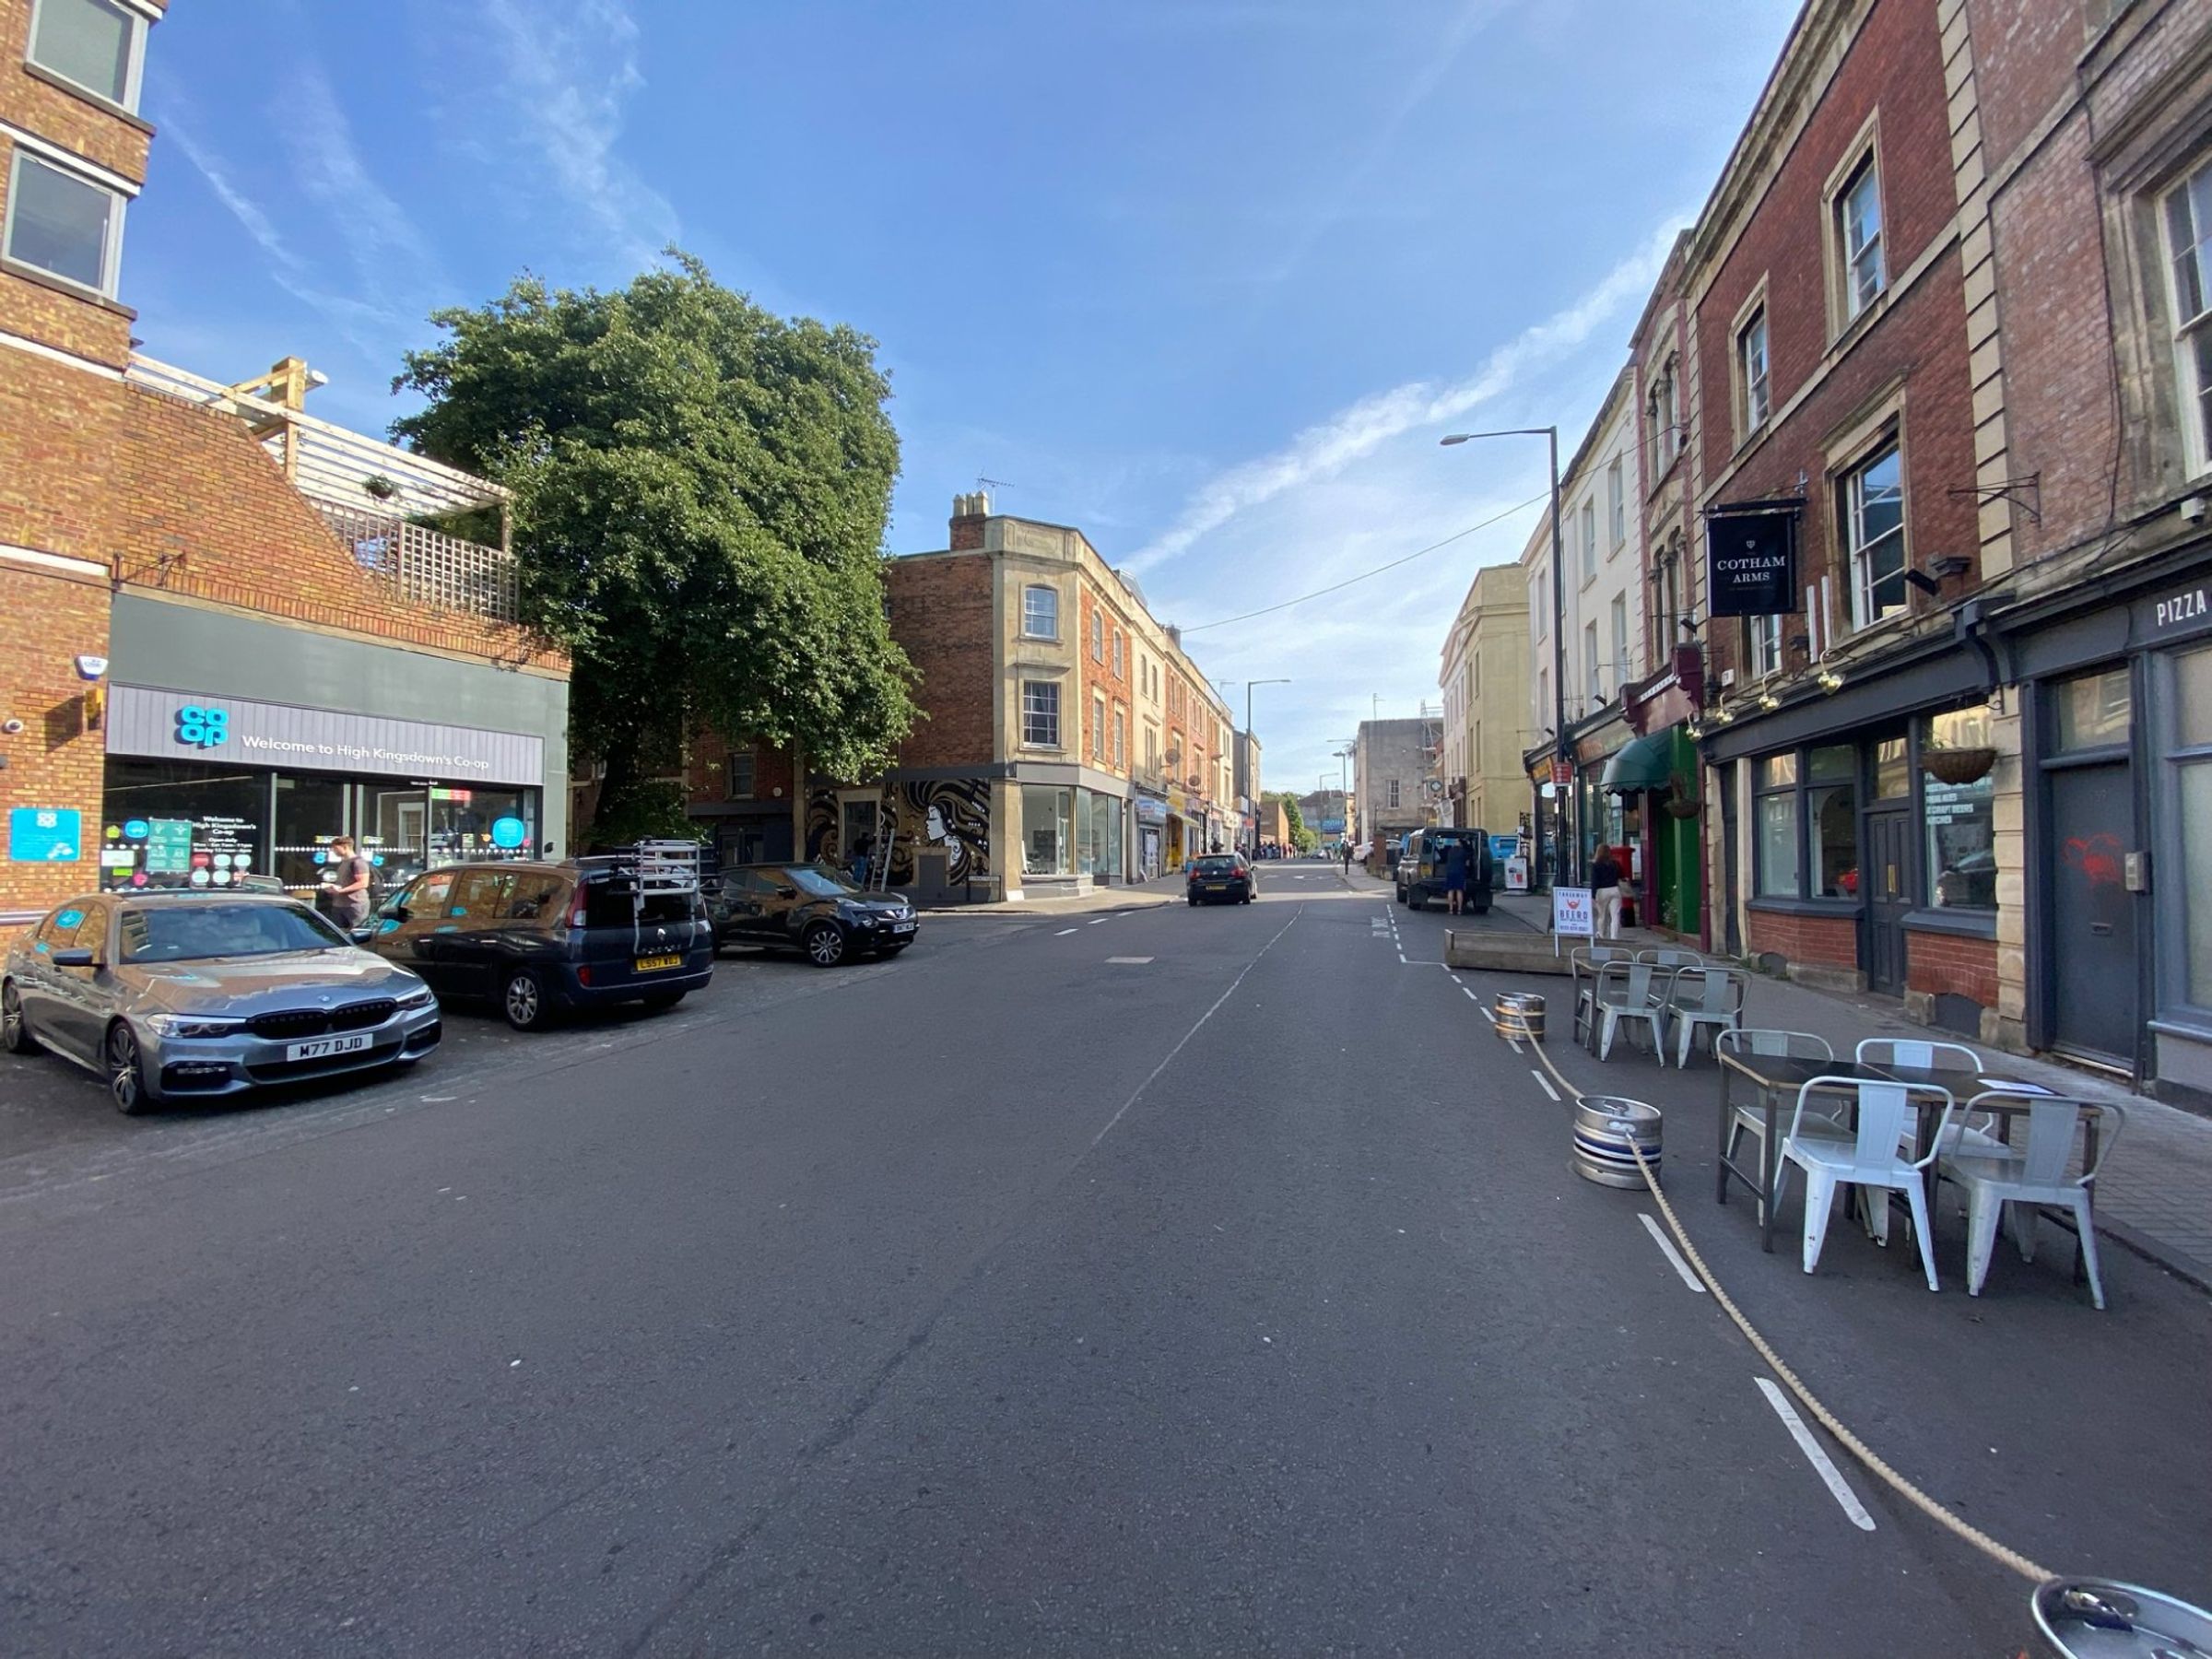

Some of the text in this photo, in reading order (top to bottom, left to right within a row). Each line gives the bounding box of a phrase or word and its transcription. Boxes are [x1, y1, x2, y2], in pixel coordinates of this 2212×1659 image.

[1717, 556, 1786, 571] COTHAM
[1733, 571, 1771, 583] ARMS
[2156, 590, 2206, 627] PIZZA
[241, 735, 489, 771] Welcome to High Kingsdown's Co-op
[335, 1037, 363, 1053] DJD
